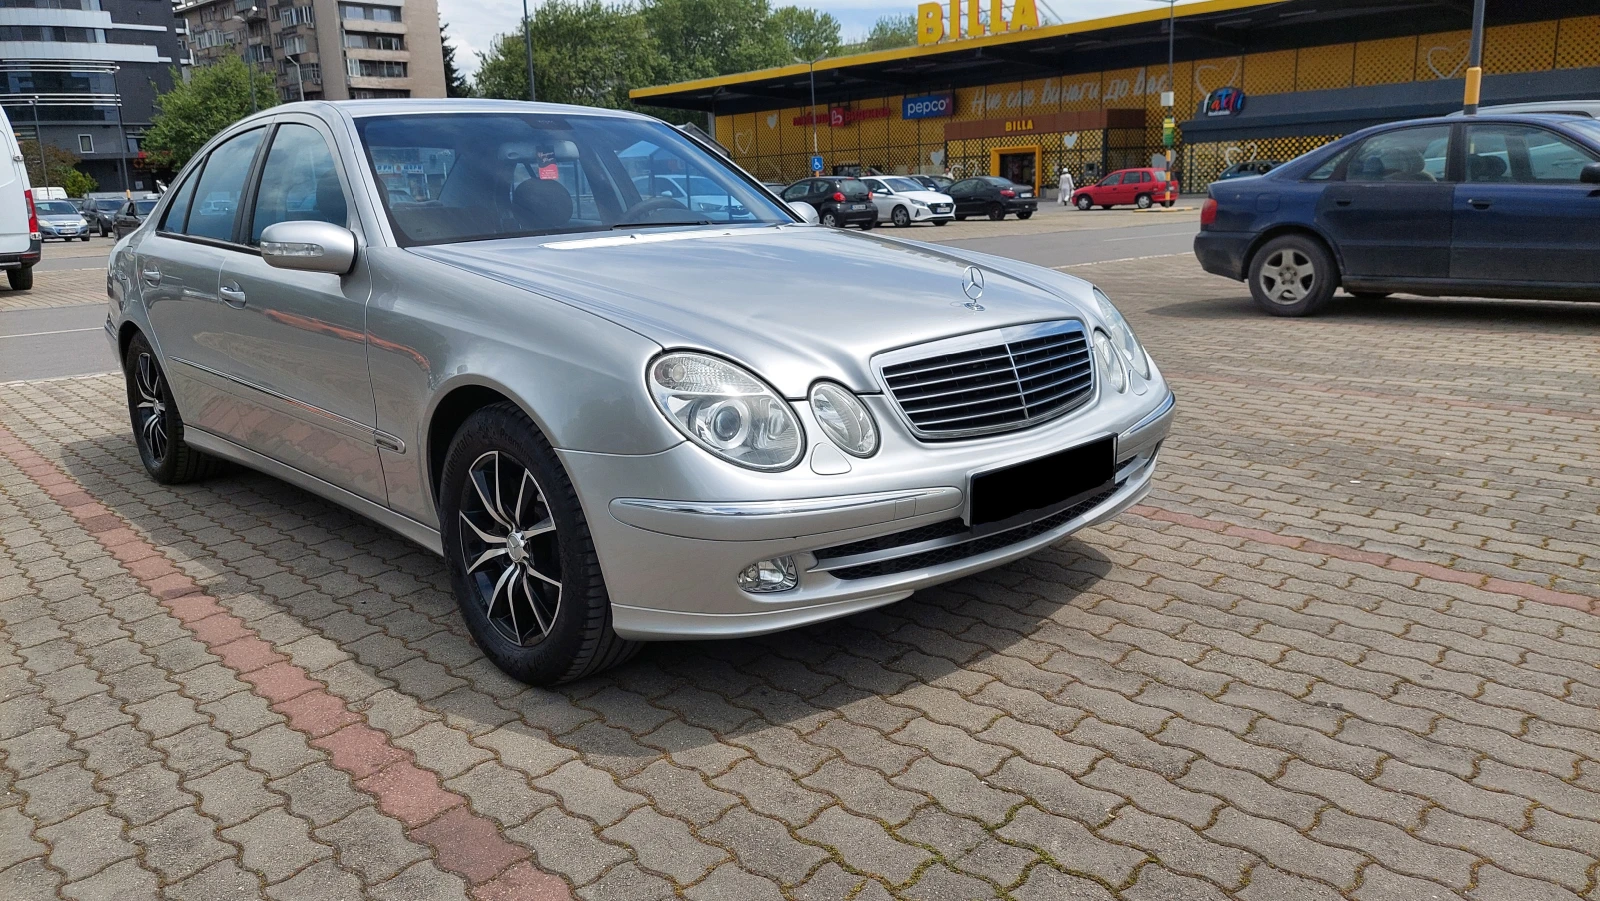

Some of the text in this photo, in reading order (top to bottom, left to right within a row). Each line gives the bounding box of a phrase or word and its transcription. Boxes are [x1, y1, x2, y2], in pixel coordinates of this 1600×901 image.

[918, 0, 1039, 45] BILLA
[907, 99, 946, 116] pepco
[1005, 119, 1033, 132] BILLA
